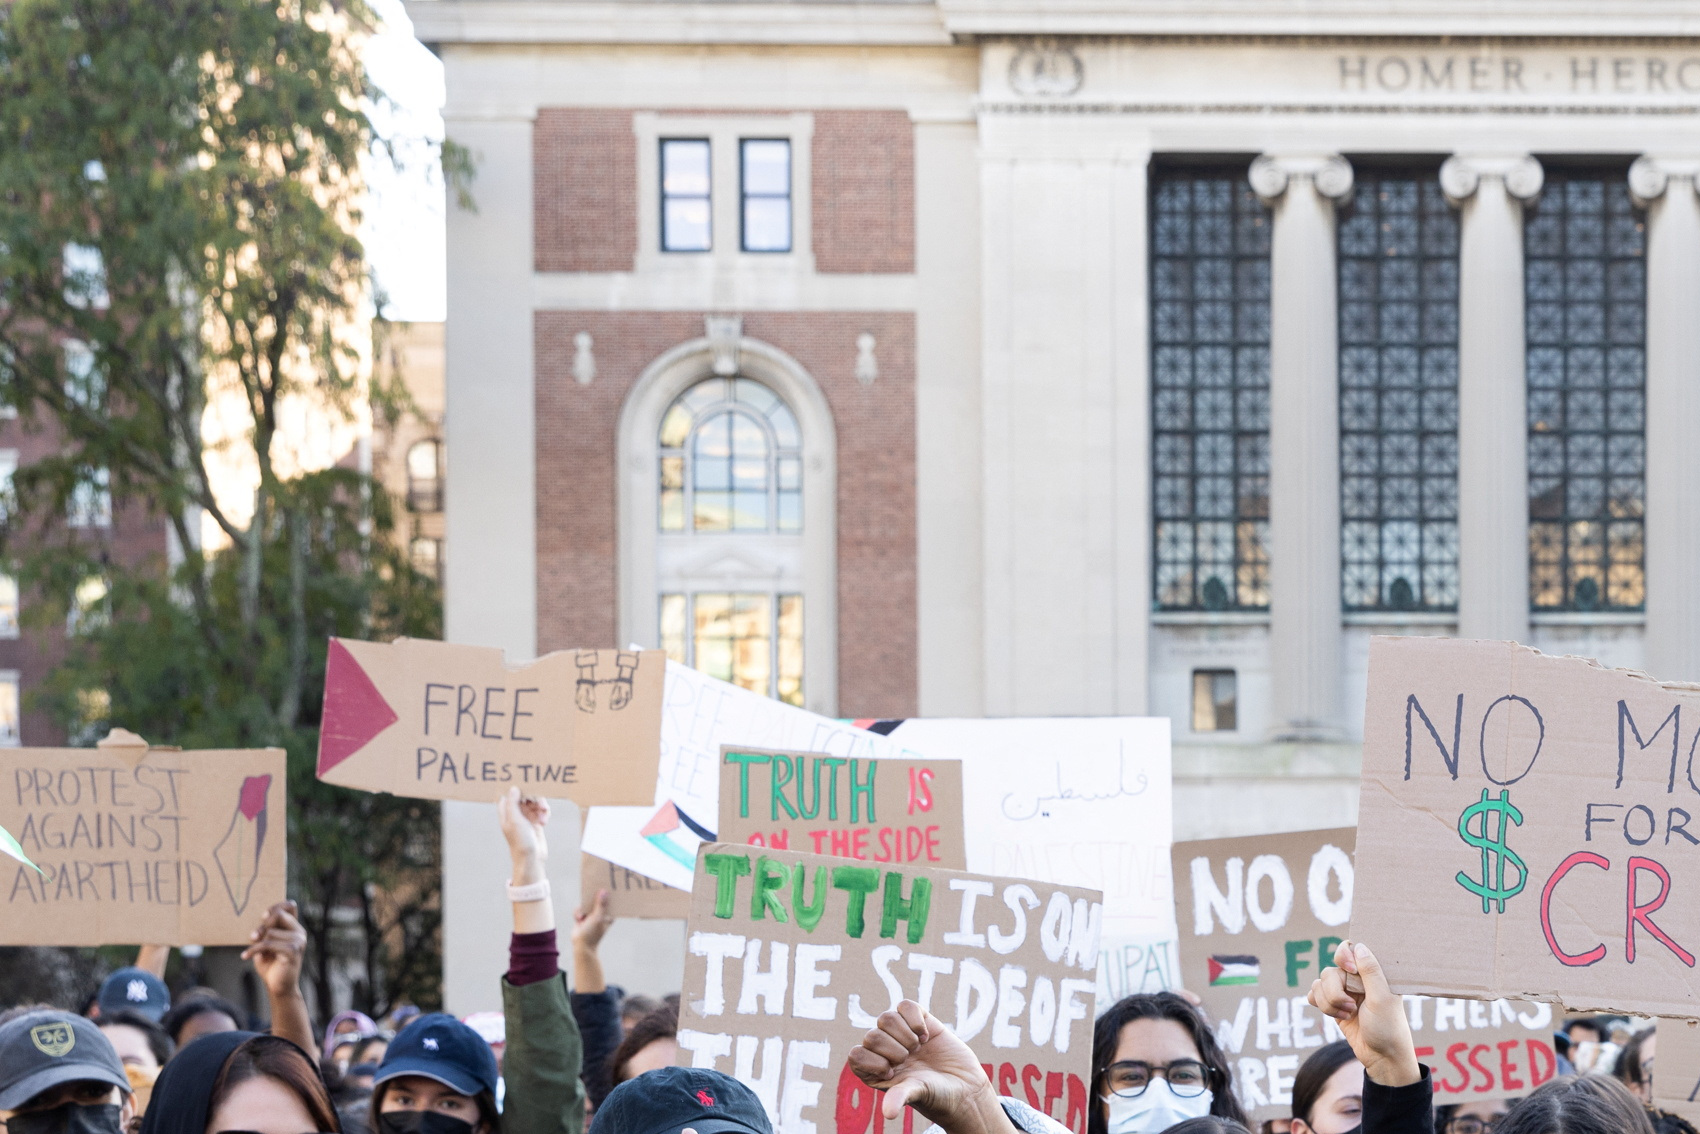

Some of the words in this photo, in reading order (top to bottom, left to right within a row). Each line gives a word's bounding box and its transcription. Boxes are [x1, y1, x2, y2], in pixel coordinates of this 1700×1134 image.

[1337, 54, 1527, 93] HOMER
[423, 683, 540, 742] FREE
[1402, 693, 1546, 787] NO
[15, 764, 190, 815] PROTEST
[416, 746, 579, 784] PALESTINE
[724, 751, 878, 823] TRUTH
[907, 766, 936, 816] IS
[20, 812, 189, 853] AGAINST
[1584, 803, 1700, 846] FOR
[8, 860, 210, 907] APARTHEID
[704, 853, 932, 945] TRUTH
[1190, 854, 1295, 936] NO
[1306, 843, 1356, 927] O
[689, 931, 842, 1020] THE
